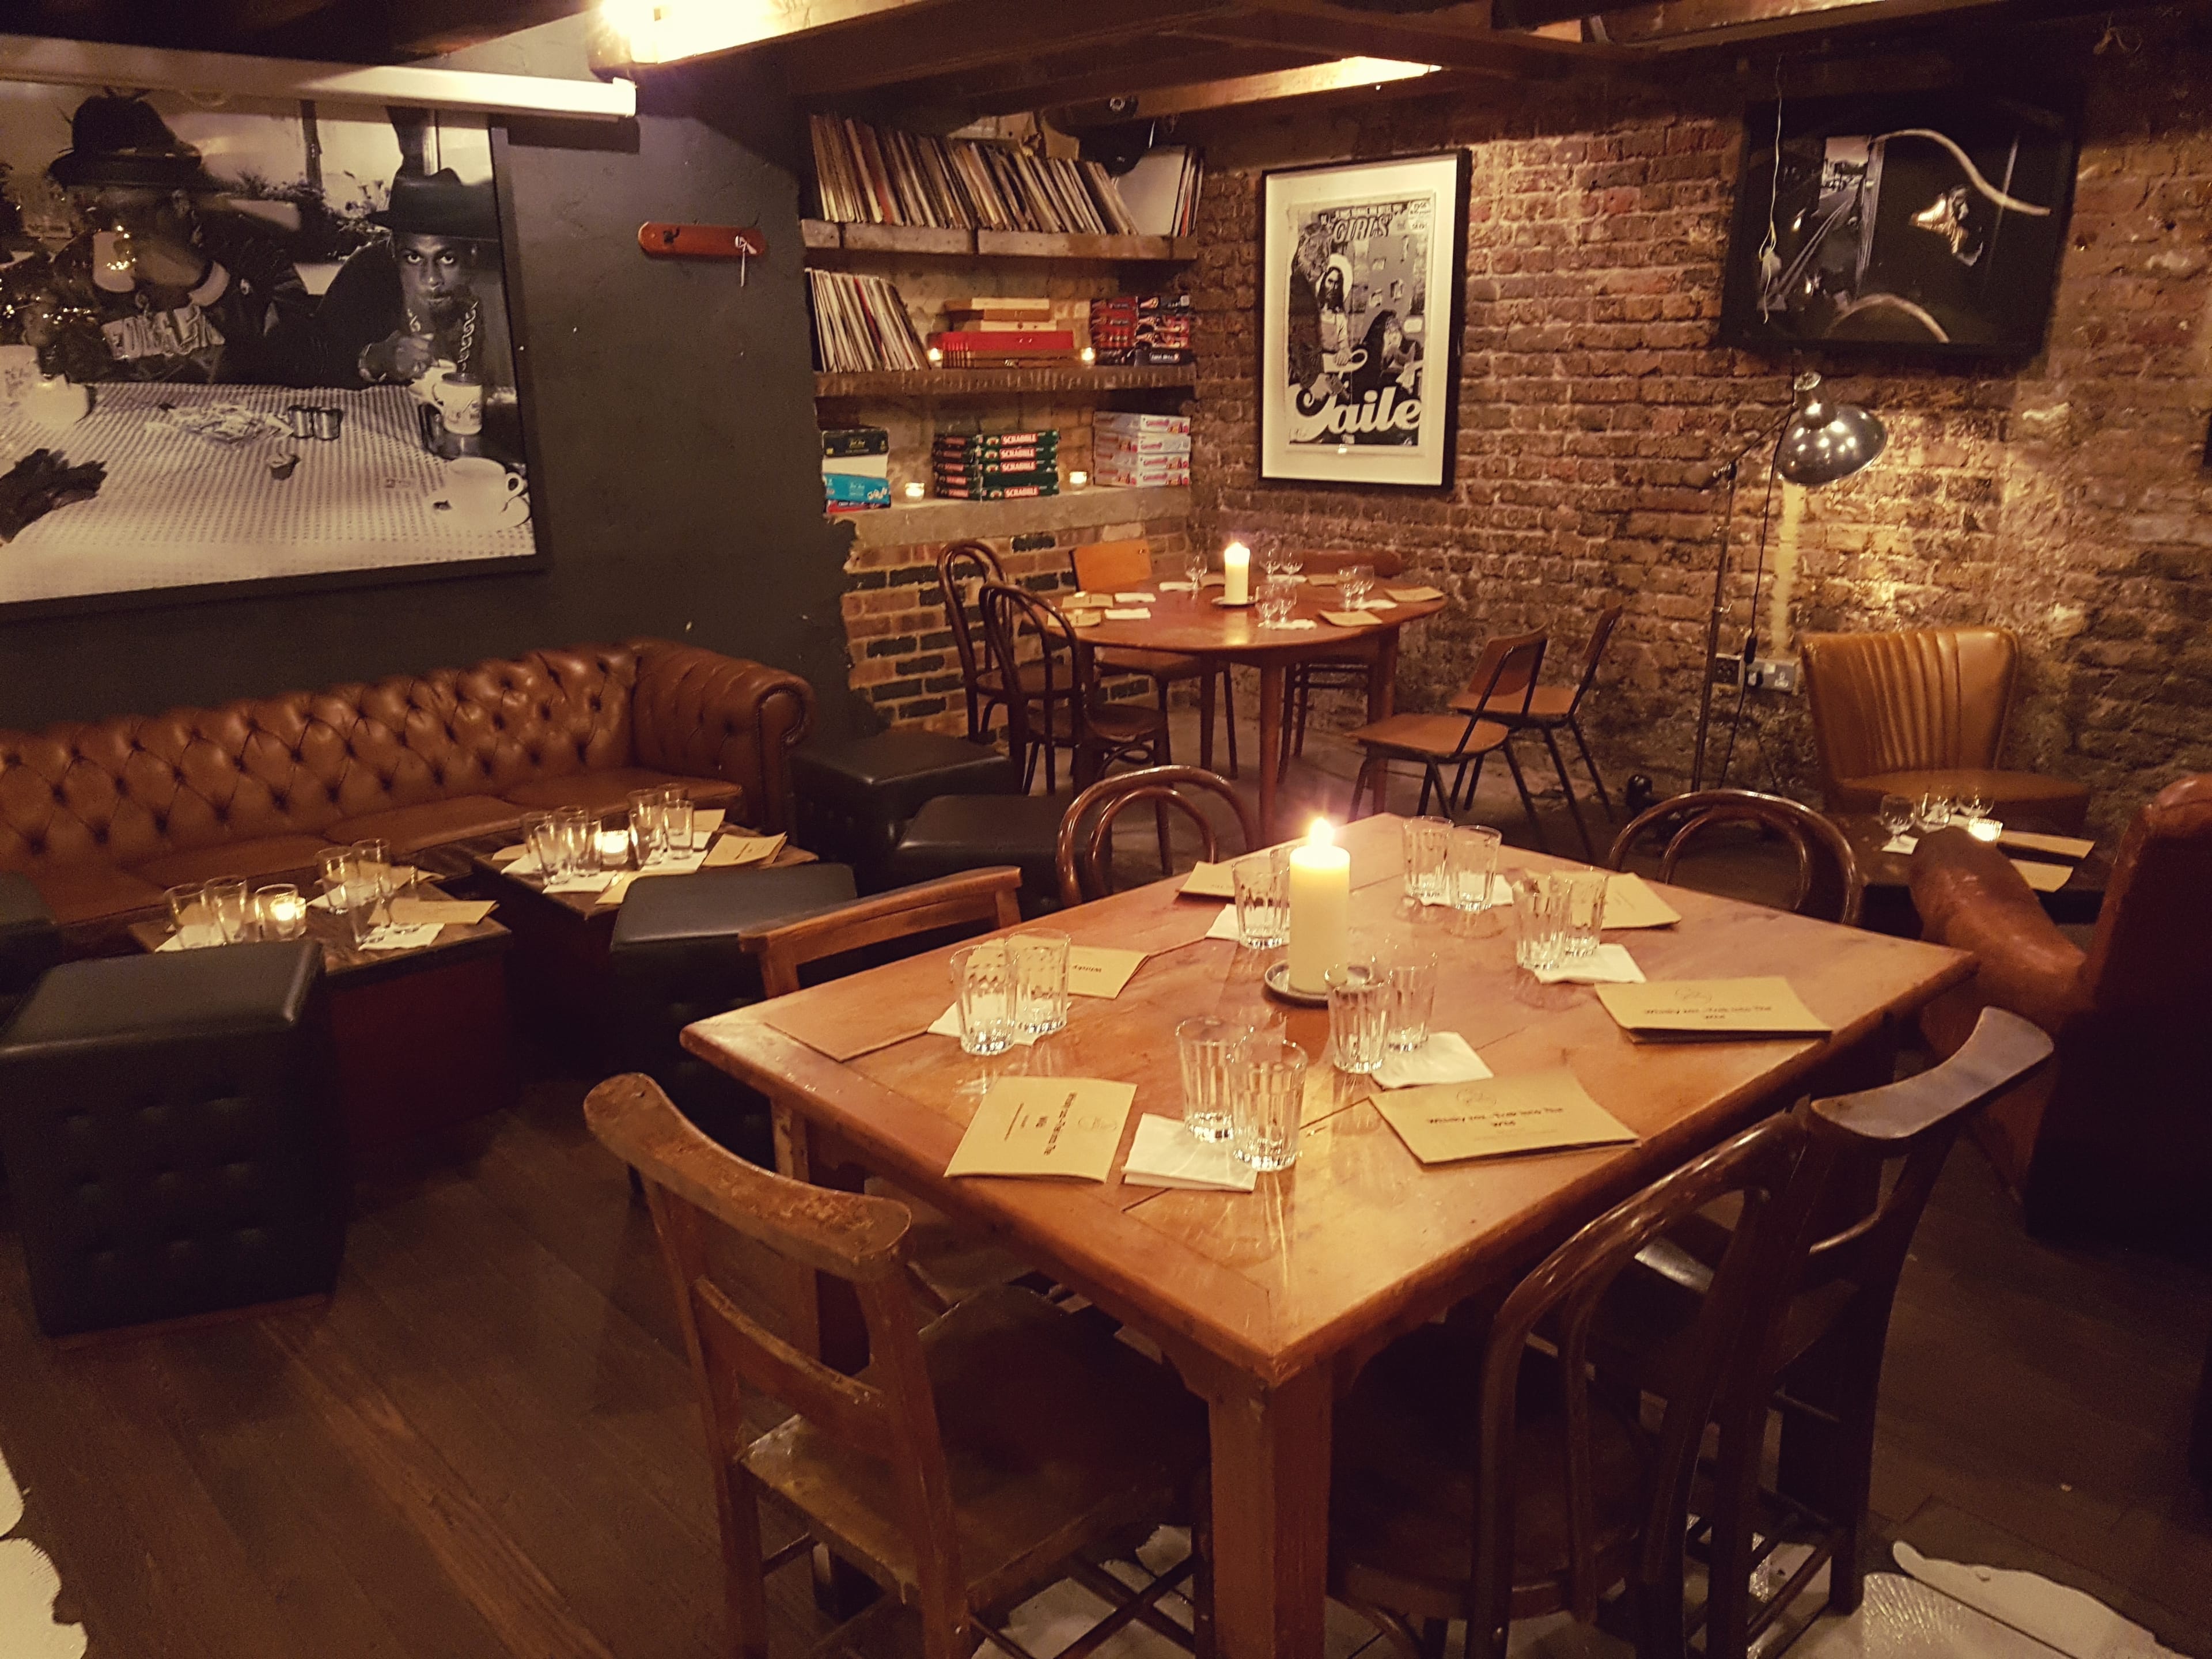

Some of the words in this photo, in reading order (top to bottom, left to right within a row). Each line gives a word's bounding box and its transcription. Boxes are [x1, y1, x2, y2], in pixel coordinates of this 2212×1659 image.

[1002, 434, 1037, 445] SCRABBLE
[1000, 448, 1036, 460] SCRABBLE
[1001, 461, 1036, 472] SCRABBLE
[1005, 486, 1039, 498] SCRABBLE
